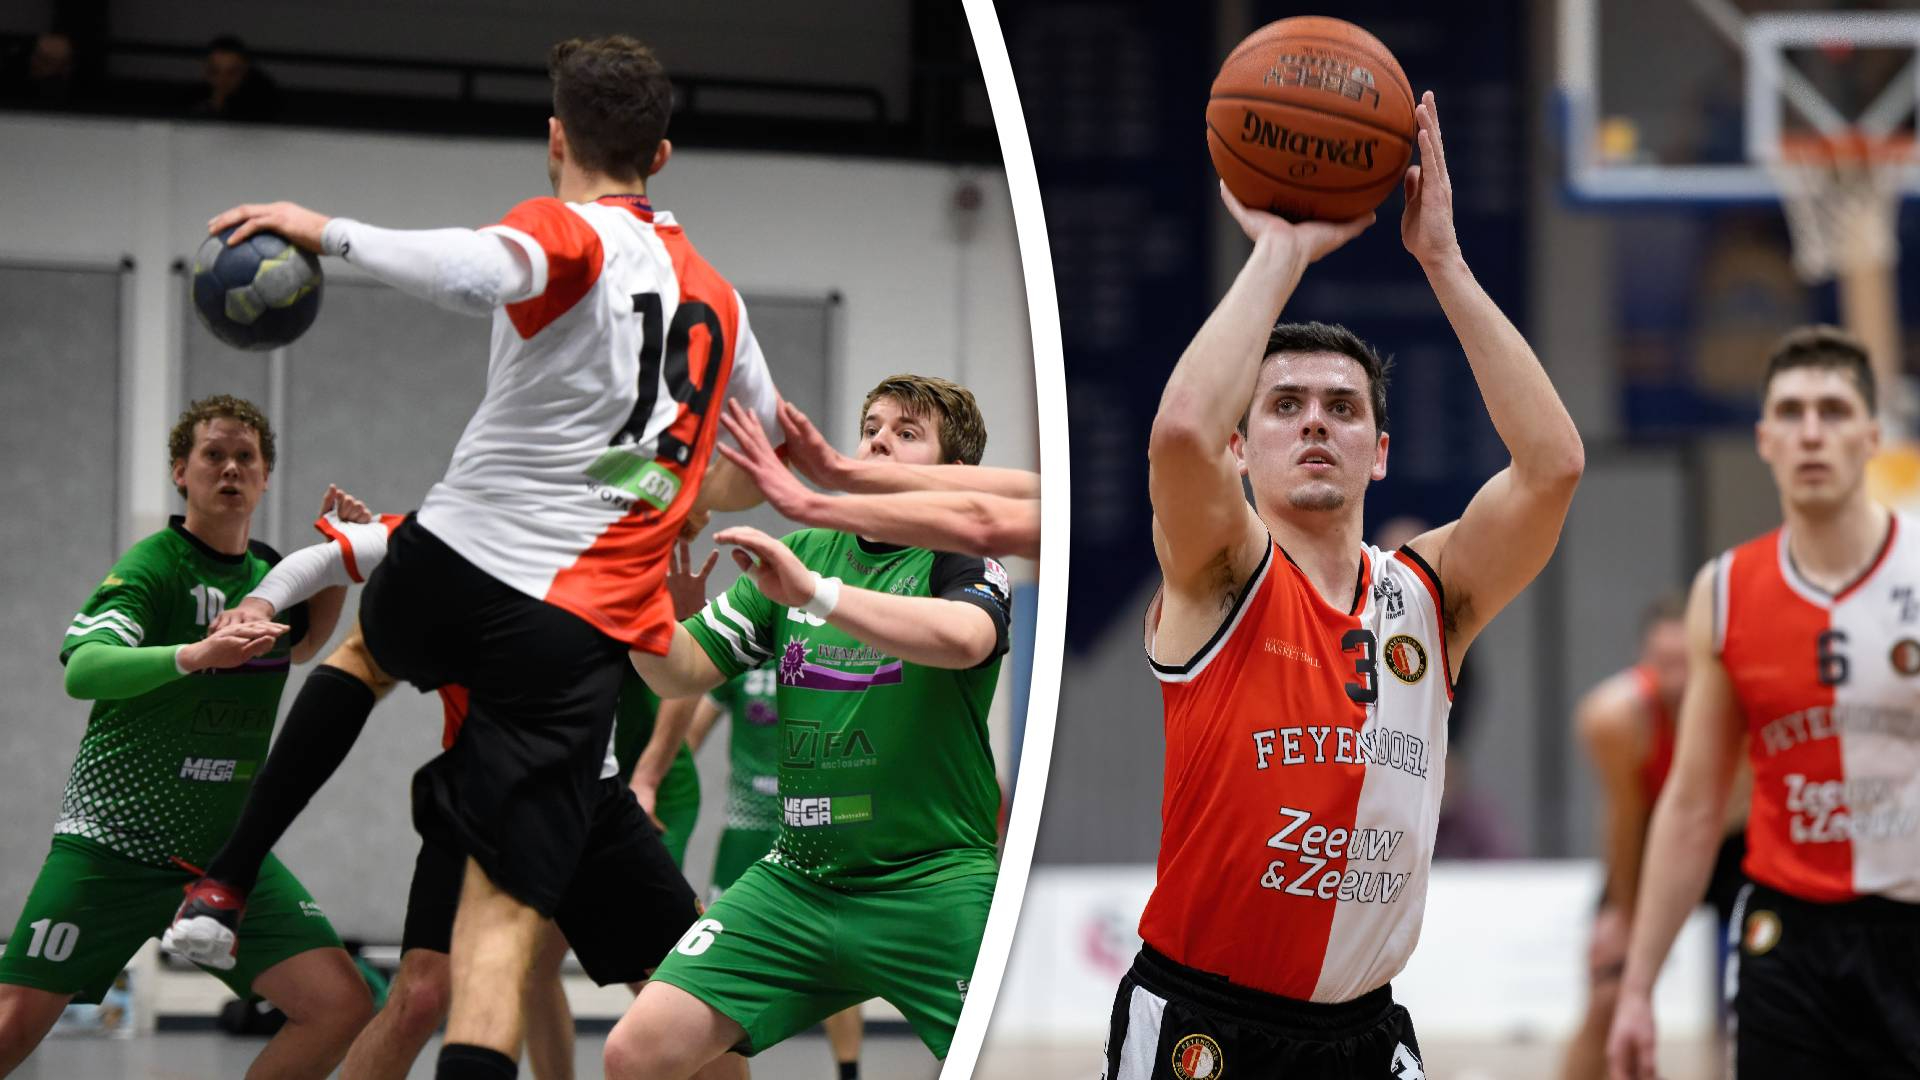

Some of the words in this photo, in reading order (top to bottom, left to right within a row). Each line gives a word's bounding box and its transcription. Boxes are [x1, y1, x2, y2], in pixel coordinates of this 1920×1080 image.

[1241, 110, 1378, 172] SPALDING
[1341, 629, 1378, 706] 3
[1819, 629, 1849, 685] 6
[1266, 805, 1404, 862] Zeeuw
[26, 917, 80, 962] 10
